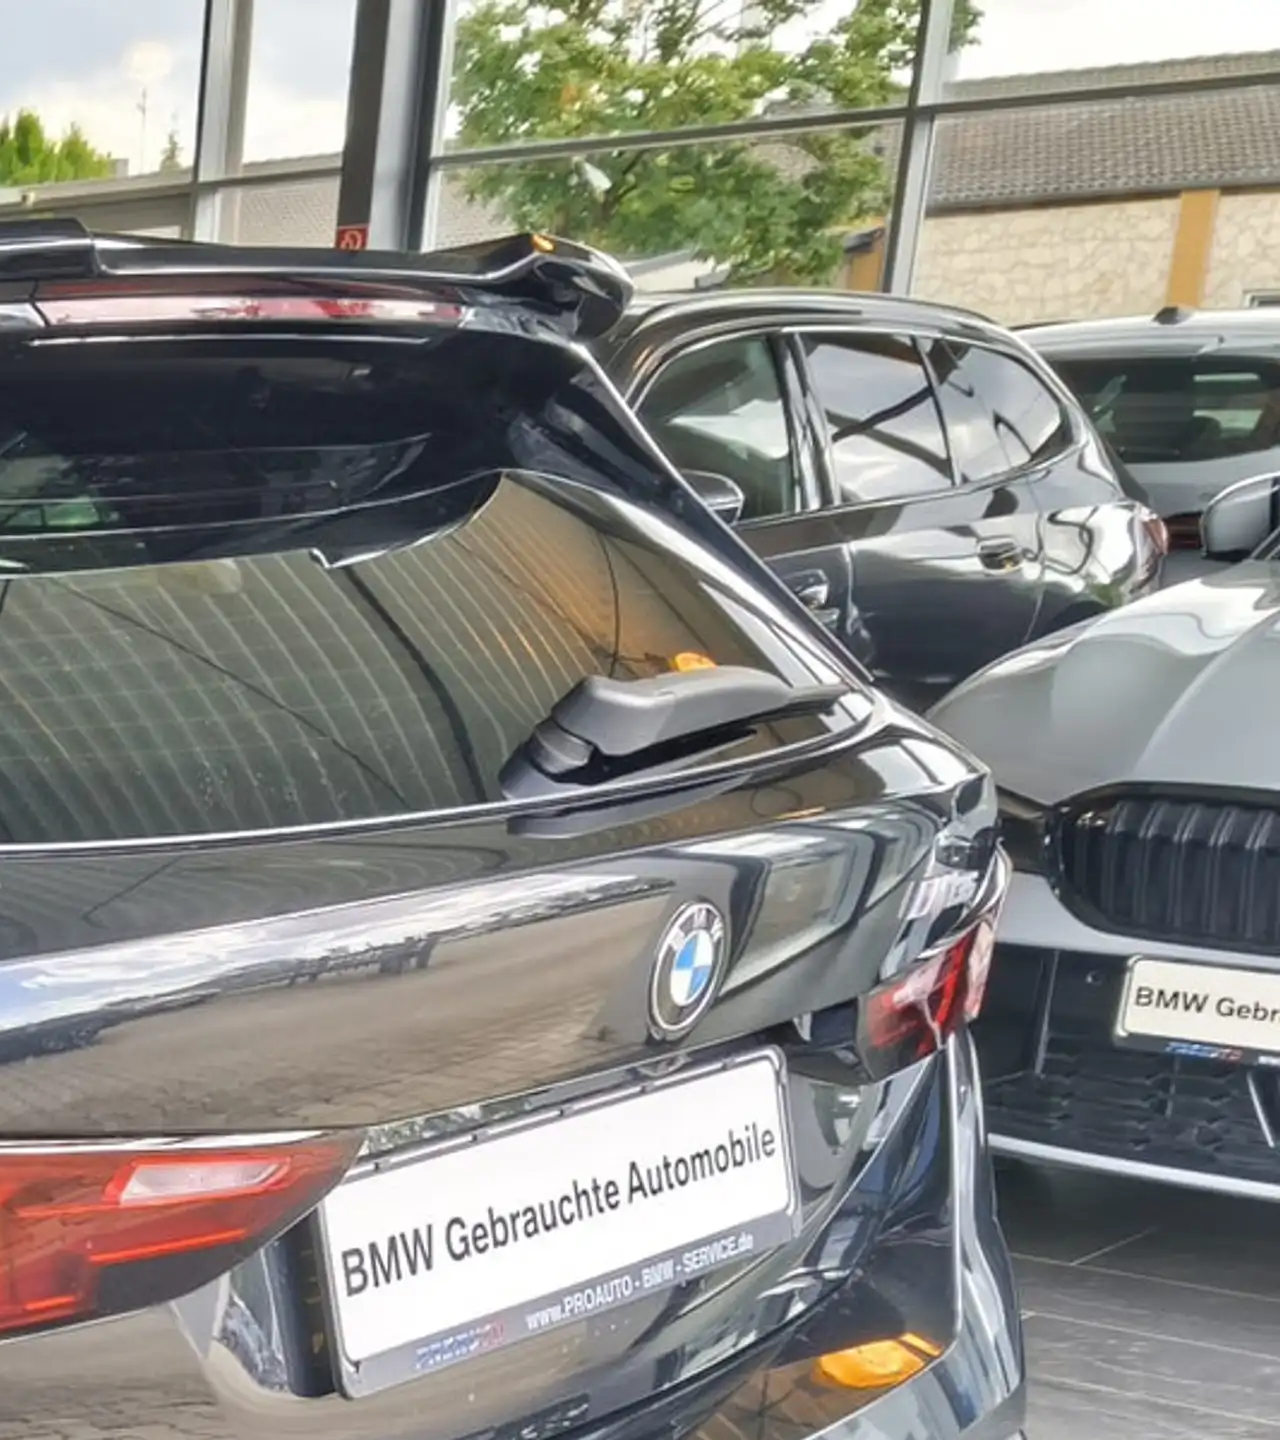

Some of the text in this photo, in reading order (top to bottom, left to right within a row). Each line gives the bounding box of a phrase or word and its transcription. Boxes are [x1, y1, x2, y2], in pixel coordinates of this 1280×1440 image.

[1135, 986, 1209, 1013] BMW
[342, 1122, 777, 1298] BMW Gebrauchte Automobile
[525, 1275, 634, 1330] www.PROAUTO
[642, 1258, 675, 1288] BMW
[682, 1232, 754, 1273] SERVICE.de
